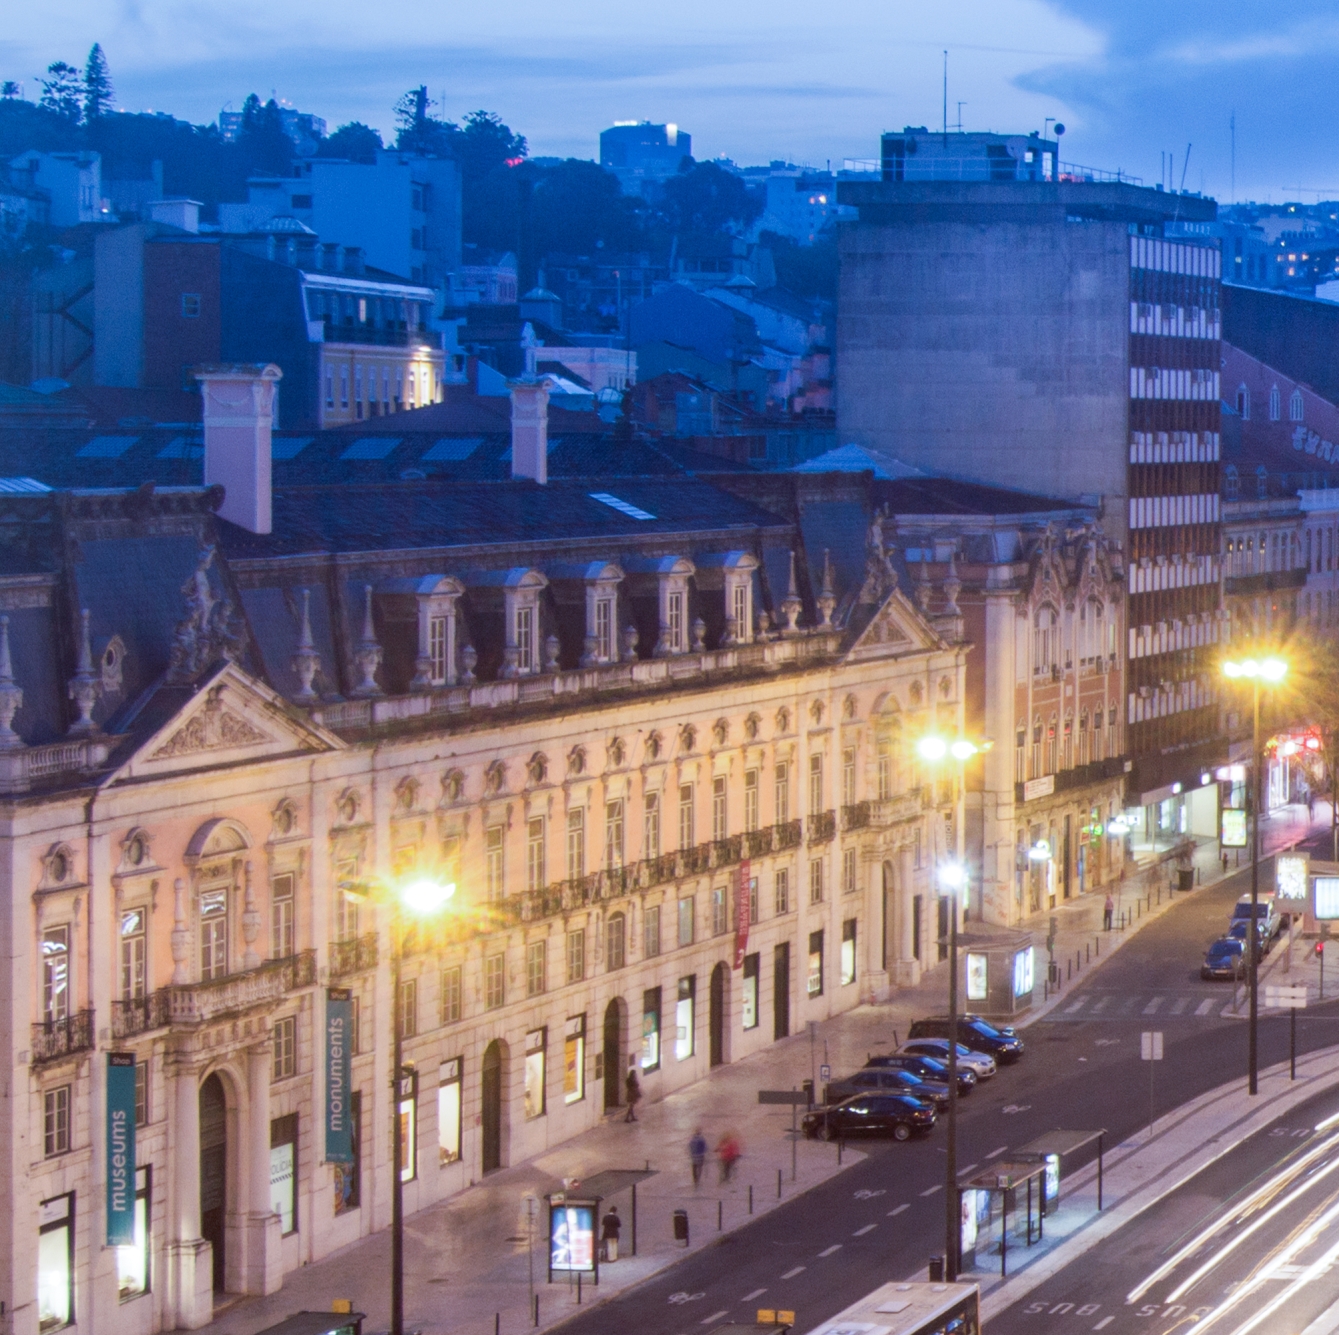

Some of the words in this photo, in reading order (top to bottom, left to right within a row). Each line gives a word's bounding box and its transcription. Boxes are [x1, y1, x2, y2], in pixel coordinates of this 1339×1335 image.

[112, 1056, 131, 1065] Shop
[330, 1017, 344, 1131] monuments
[112, 1109, 126, 1212] museums
[1023, 1302, 1101, 1315] BUS
